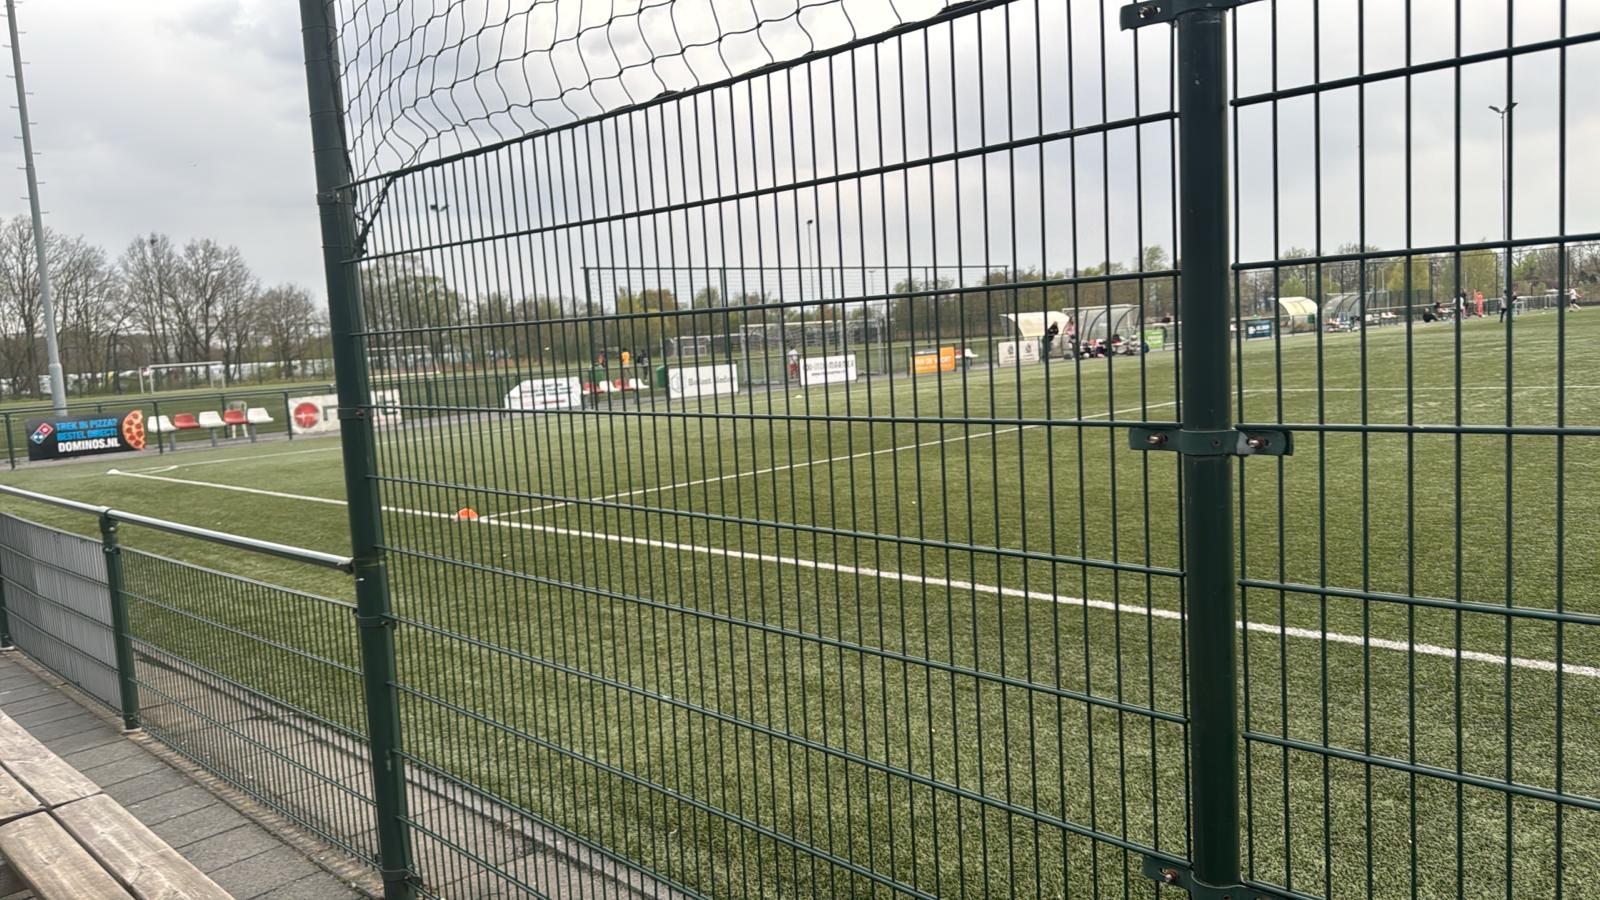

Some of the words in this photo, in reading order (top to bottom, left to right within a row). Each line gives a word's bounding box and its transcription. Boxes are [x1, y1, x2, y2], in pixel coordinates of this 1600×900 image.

[56, 421, 78, 431] TREK
[79, 420, 88, 429] IN
[89, 418, 118, 428] PIZZA?
[56, 431, 87, 442] BESTEL
[58, 437, 121, 453] DOMINOS.NL
